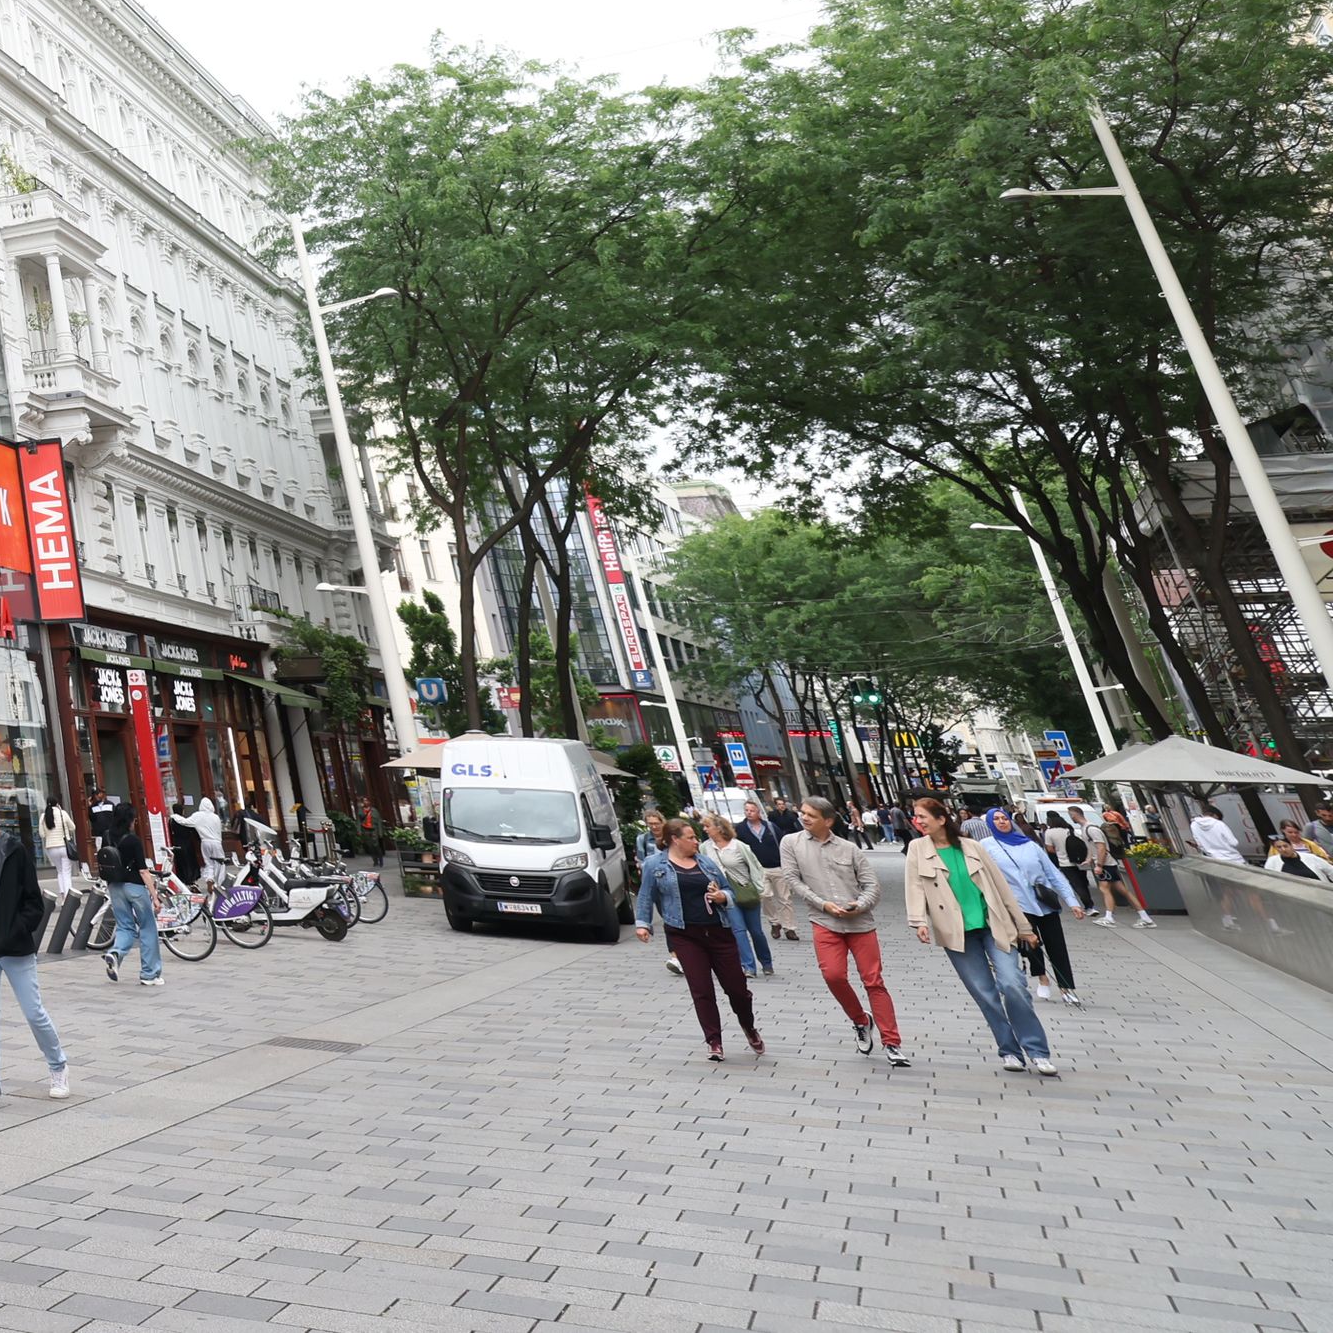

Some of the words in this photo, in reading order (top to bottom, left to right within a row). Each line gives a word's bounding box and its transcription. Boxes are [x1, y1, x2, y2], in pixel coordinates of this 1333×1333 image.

[28, 470, 74, 591] HEMA
[593, 508, 620, 572] HalfPice
[614, 594, 641, 663] EUROSPAR
[97, 667, 122, 687] JACK&
[99, 685, 125, 705] JONES
[173, 680, 195, 697] JACK&
[420, 682, 439, 702] U
[175, 695, 197, 712] JONES
[451, 763, 493, 778] GLS
